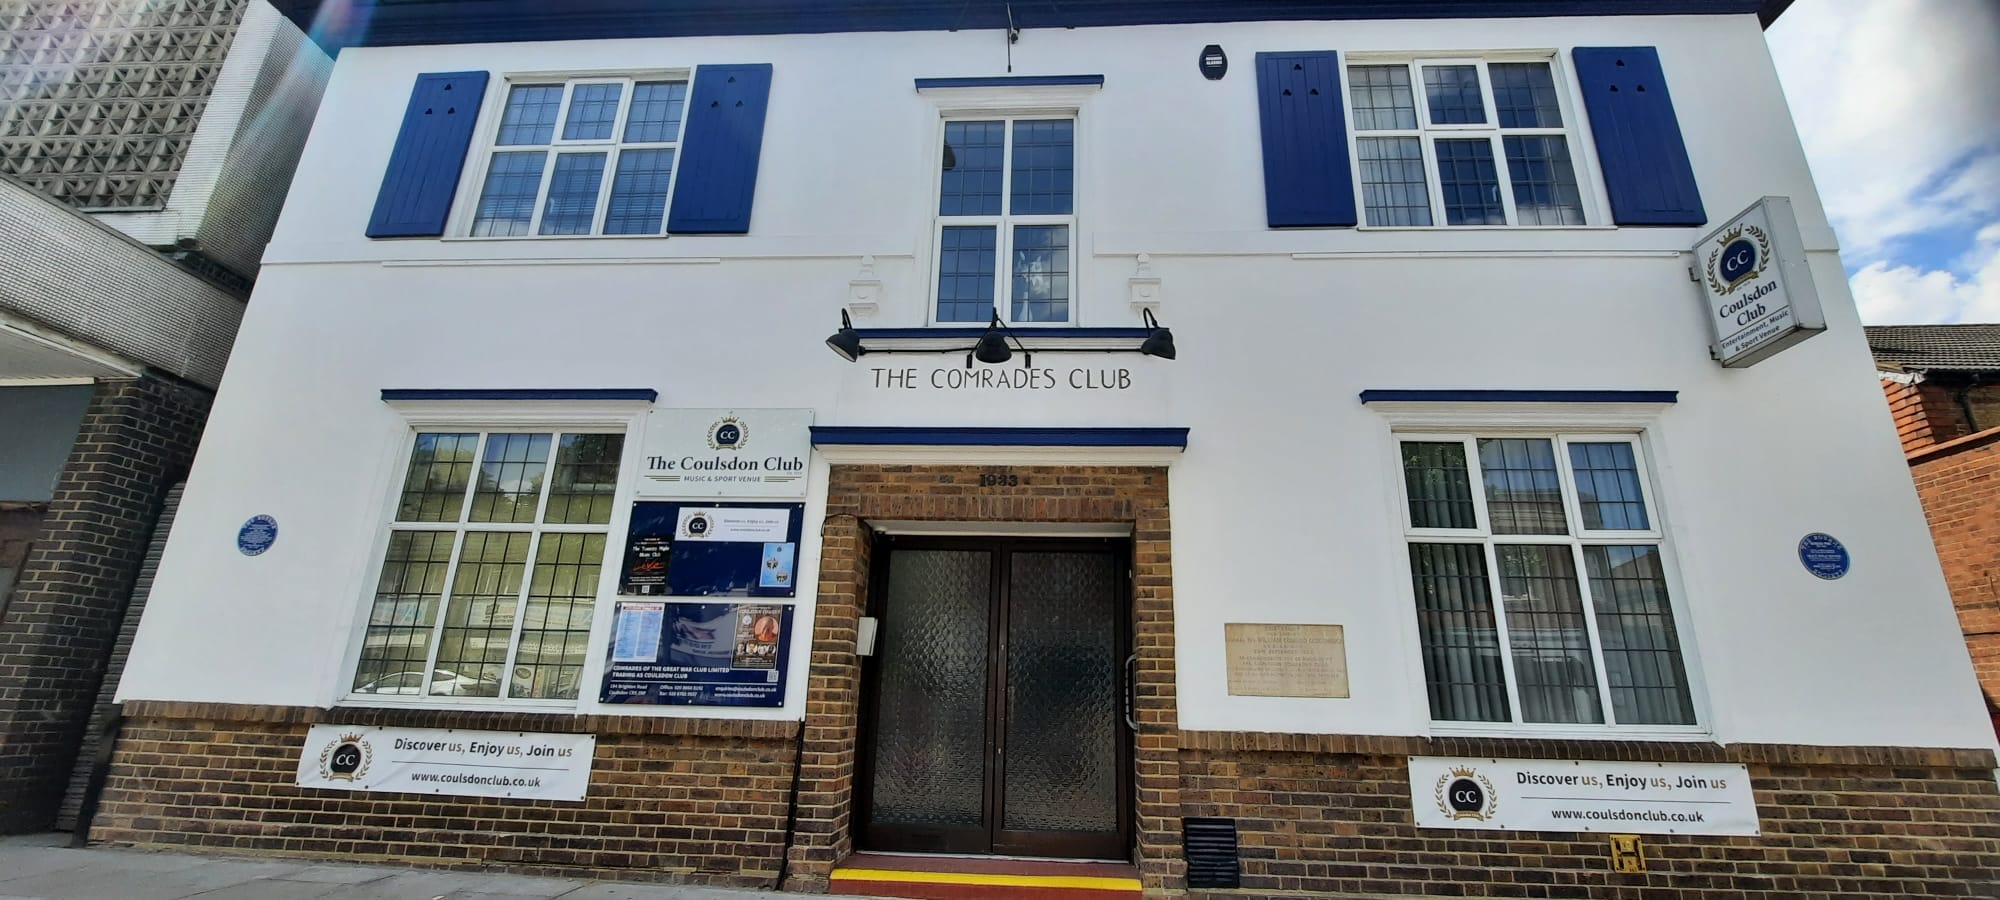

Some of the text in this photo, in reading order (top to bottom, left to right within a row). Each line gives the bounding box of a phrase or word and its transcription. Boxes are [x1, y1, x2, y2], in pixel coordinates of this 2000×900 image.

[1726, 249, 1749, 272] CC
[1719, 280, 1777, 318] Coulsdon
[1736, 304, 1766, 326] Club
[1722, 310, 1789, 349] Entertainment, Music
[1740, 336, 1758, 350] Sport
[1759, 324, 1780, 342] Venue
[871, 368, 1132, 390] THE COMRADES CLUB
[720, 430, 736, 440] CC
[647, 456, 803, 471] The Coulsdon Club
[394, 738, 573, 758] Discover us, Enjoy us, Join us
[336, 754, 356, 766] CC
[411, 770, 541, 788] www.coulsdonclub.co.uk
[1516, 772, 1727, 790] Discover us, Enjoy us, Join us
[1455, 790, 1477, 804] CC
[1551, 808, 1704, 822] www.coulsdonclub.co.uk
